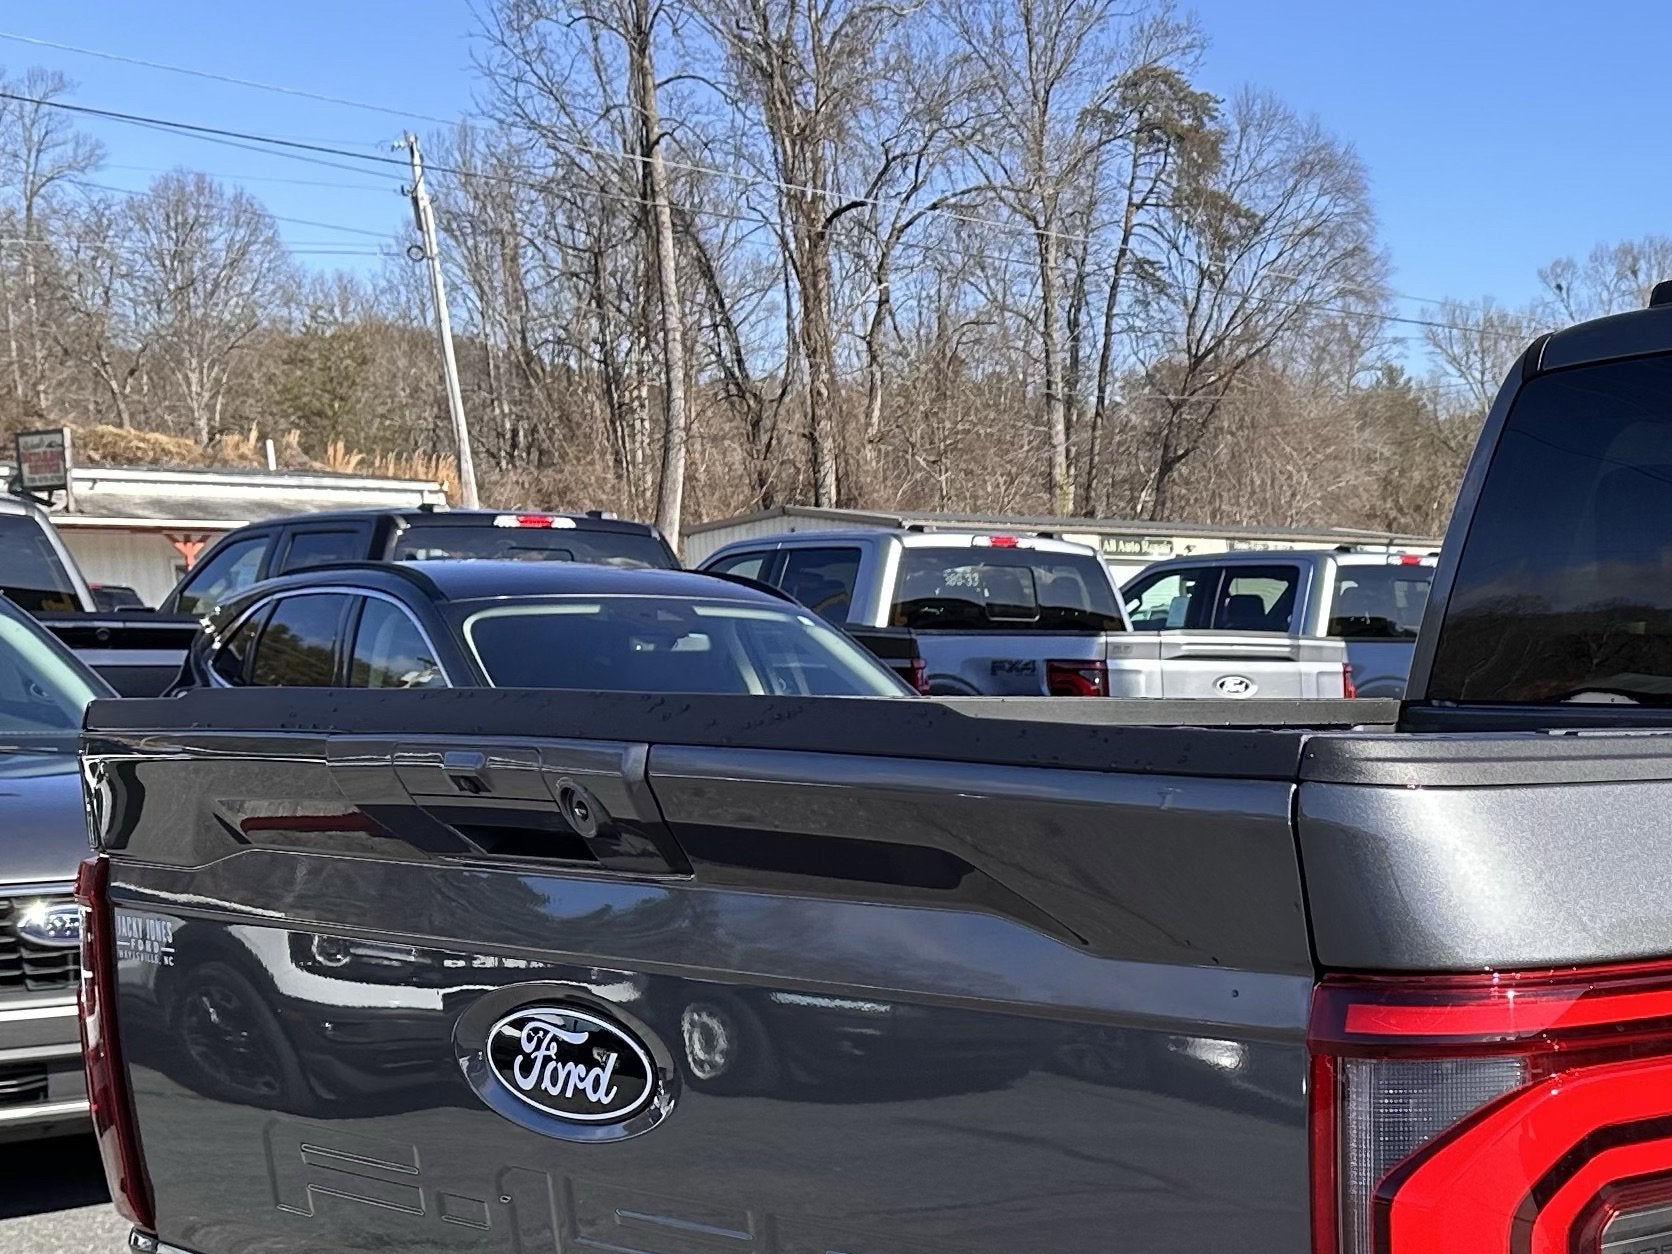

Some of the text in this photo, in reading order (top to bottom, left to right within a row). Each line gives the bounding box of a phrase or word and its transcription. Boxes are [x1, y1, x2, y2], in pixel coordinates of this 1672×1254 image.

[116, 915, 173, 943] JACKY JONES
[130, 938, 160, 954] FORD
[513, 1021, 618, 1105] Ford
